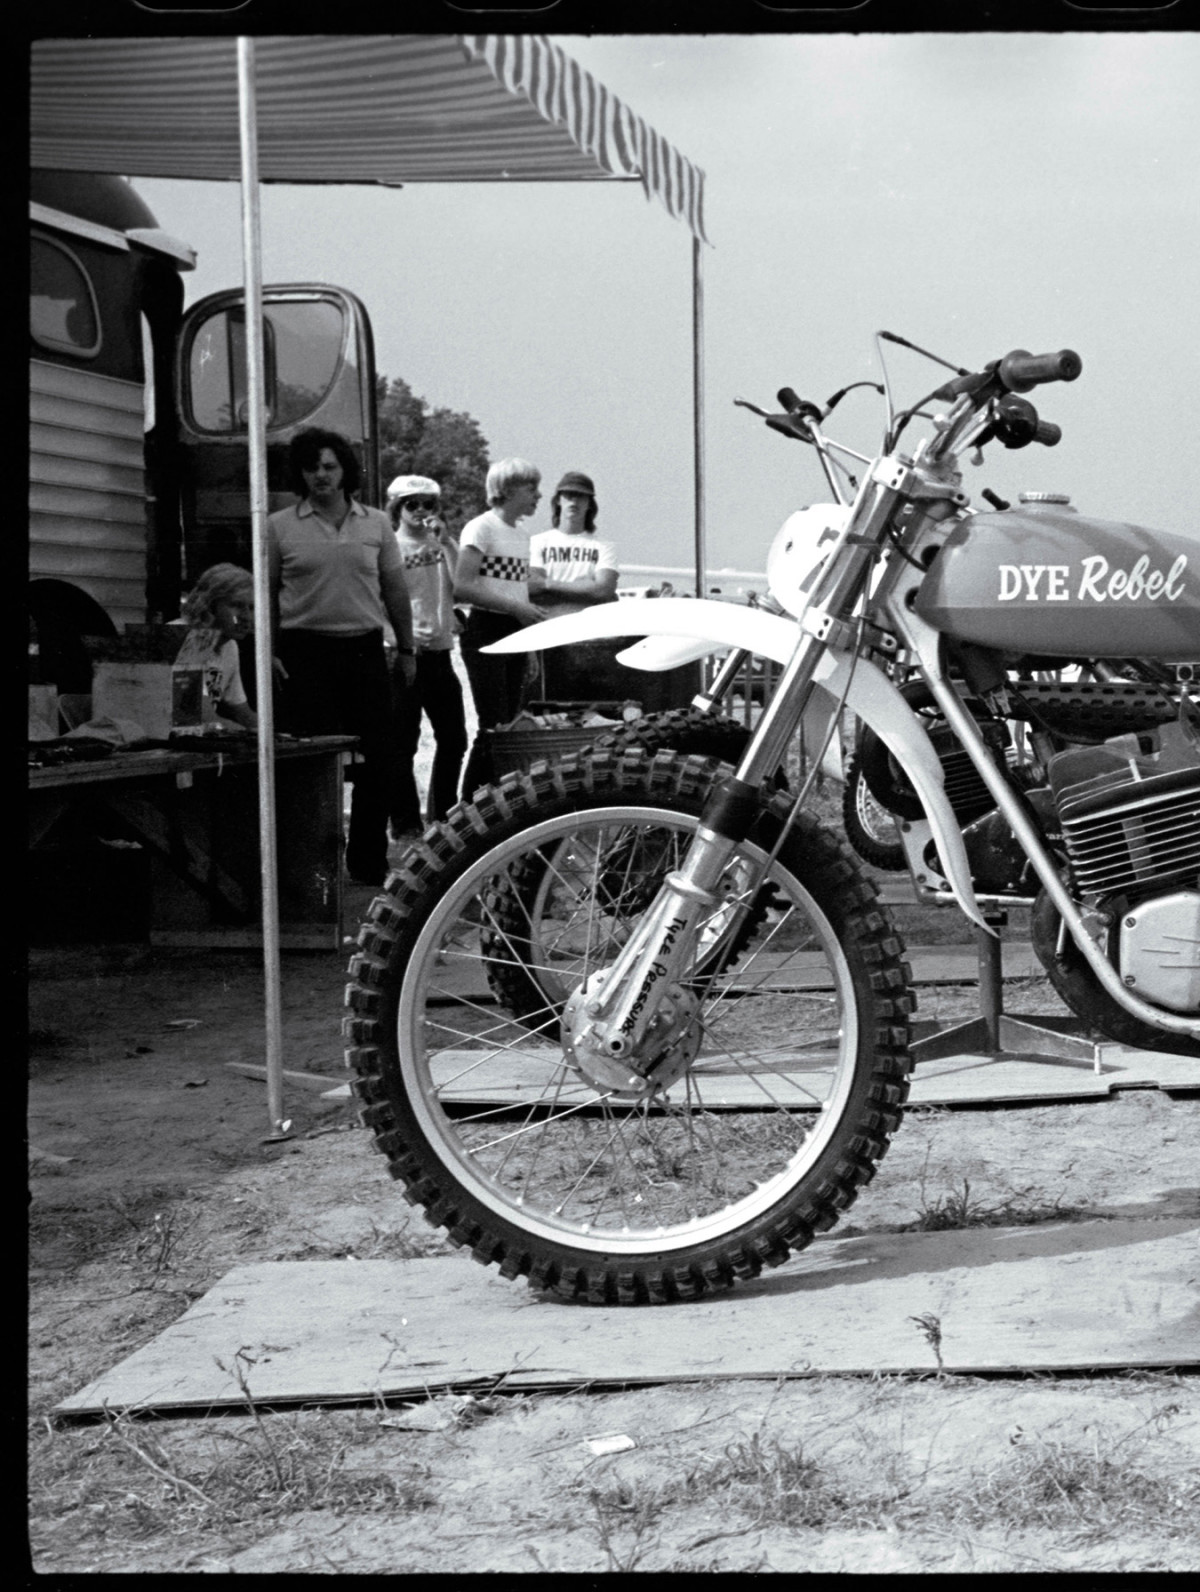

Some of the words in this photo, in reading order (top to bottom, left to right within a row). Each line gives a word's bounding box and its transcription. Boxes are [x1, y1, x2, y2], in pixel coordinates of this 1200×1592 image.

[541, 546, 599, 565] YAMAHA
[998, 565, 1070, 601] DYE
[1077, 554, 1188, 602] Rebel
